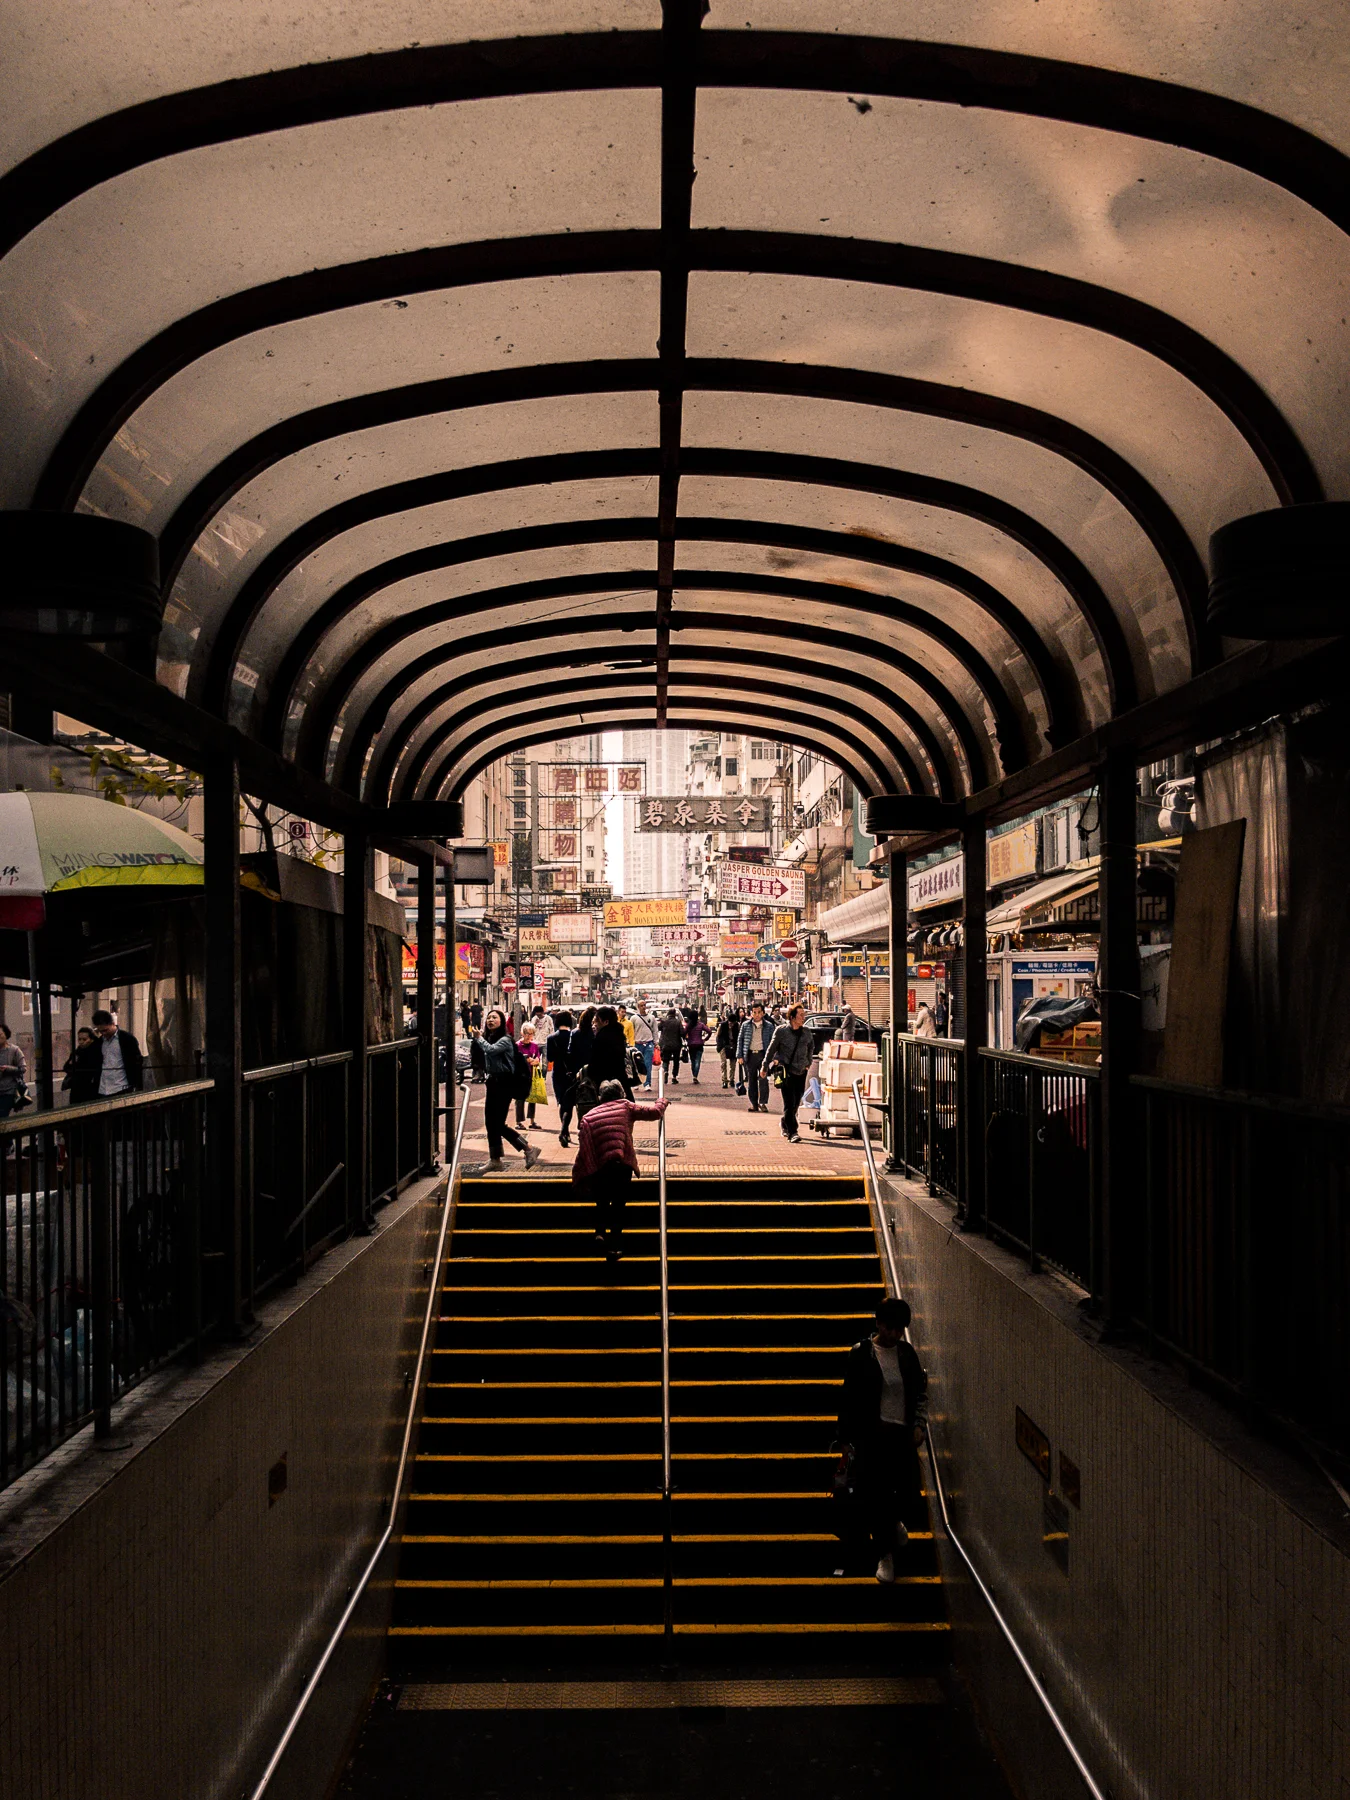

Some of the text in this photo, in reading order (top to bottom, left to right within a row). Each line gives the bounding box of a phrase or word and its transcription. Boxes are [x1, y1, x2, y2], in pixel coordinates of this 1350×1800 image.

[643, 799, 759, 826] 碧泉桑拿
[723, 863, 750, 874] JASPER
[752, 866, 780, 877] GOLDEN
[781, 869, 804, 879] SAUNA
[634, 915, 685, 925] MONEY EXCHANGE
